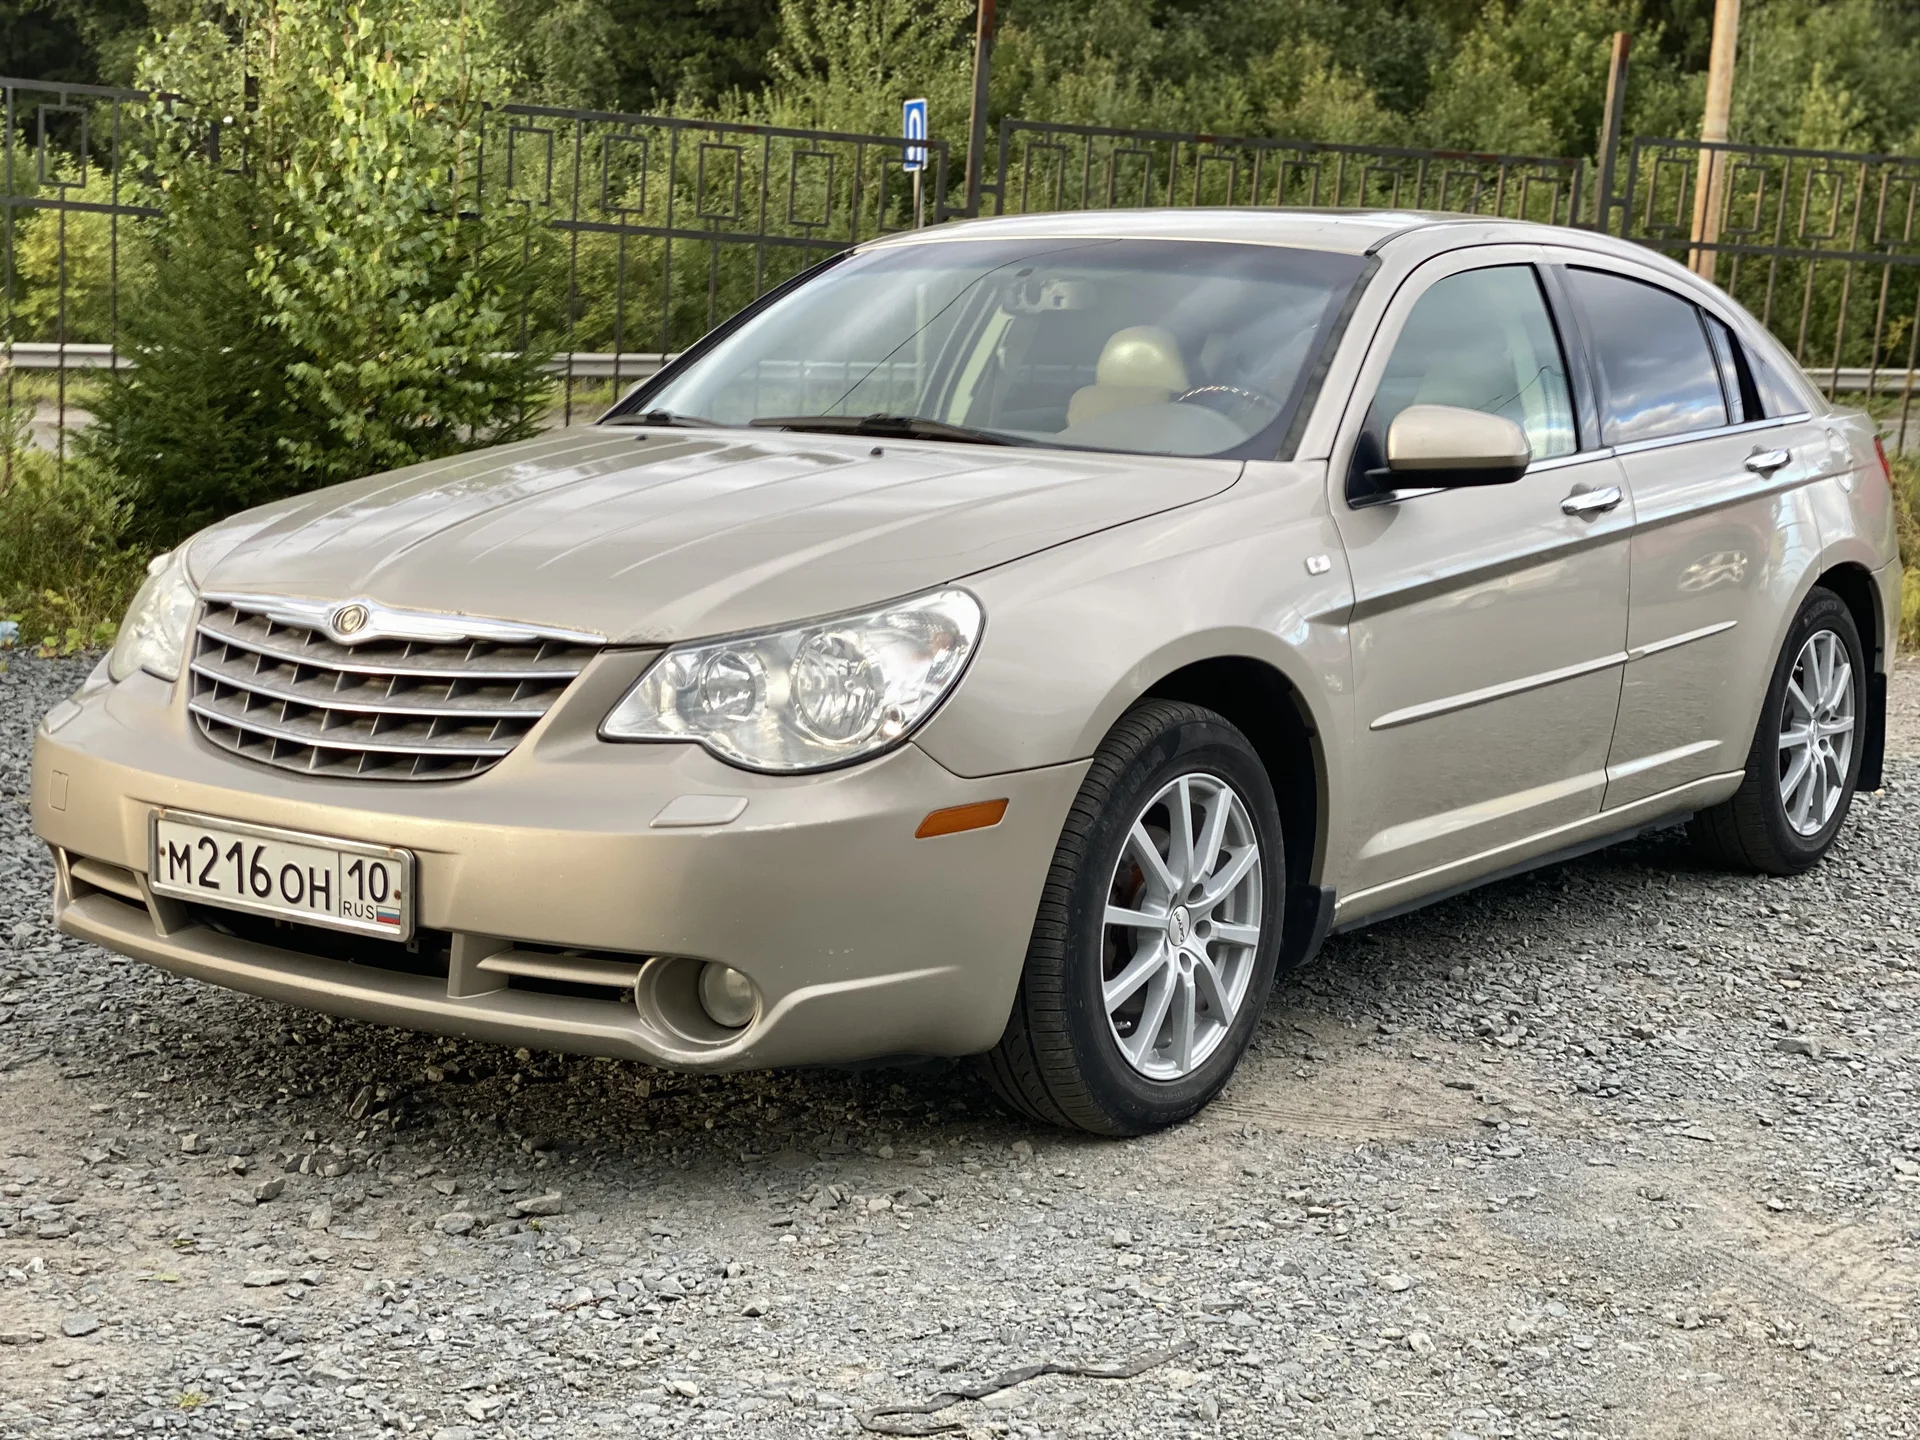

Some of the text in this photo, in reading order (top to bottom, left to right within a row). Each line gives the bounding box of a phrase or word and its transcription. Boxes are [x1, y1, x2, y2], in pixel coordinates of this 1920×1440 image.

[168, 835, 389, 911] М216ОН 10
[343, 900, 375, 921] RUS
